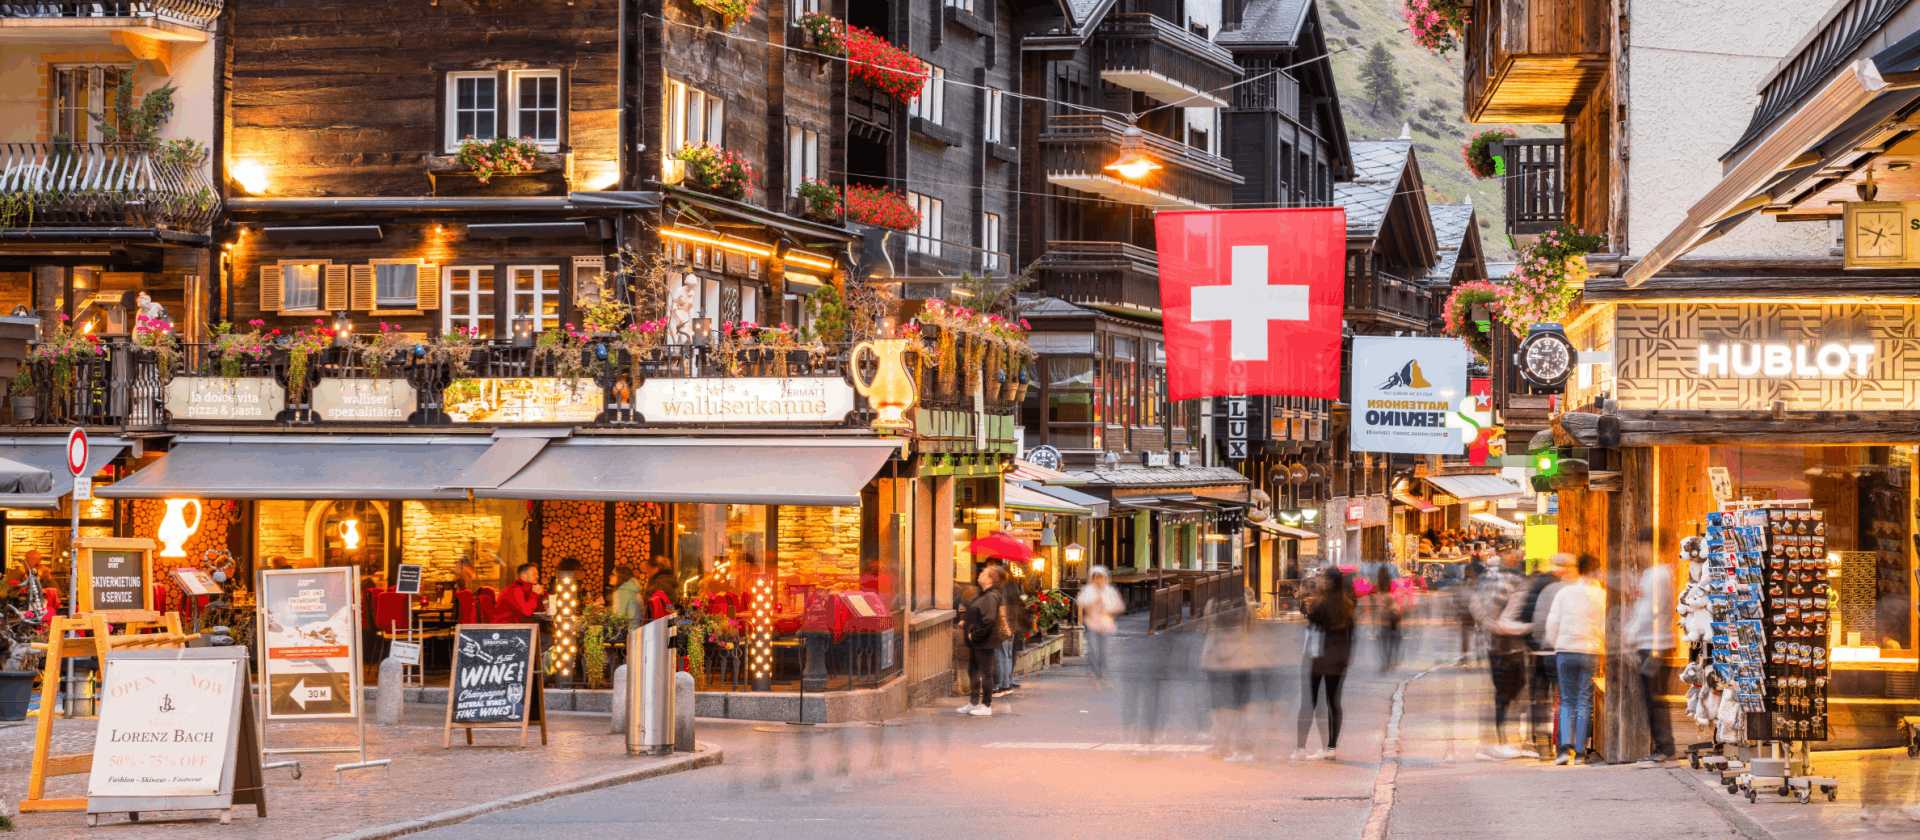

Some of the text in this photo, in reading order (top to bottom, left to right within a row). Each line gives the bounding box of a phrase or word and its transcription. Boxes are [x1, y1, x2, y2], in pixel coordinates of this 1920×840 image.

[1698, 343, 1875, 376] HUBLOT
[237, 391, 259, 403] vita
[342, 392, 388, 405] walliser
[187, 404, 218, 417] pizza
[231, 405, 263, 417] pasta
[662, 394, 827, 416] walliserkanne
[107, 591, 132, 602] SERVICE
[461, 661, 525, 688] WINE!
[110, 673, 224, 697] OPEN NOW
[307, 689, 327, 698] 30 M
[456, 705, 512, 719] FINE WINES
[178, 752, 209, 766] OFF
[108, 775, 135, 784] Fashion
